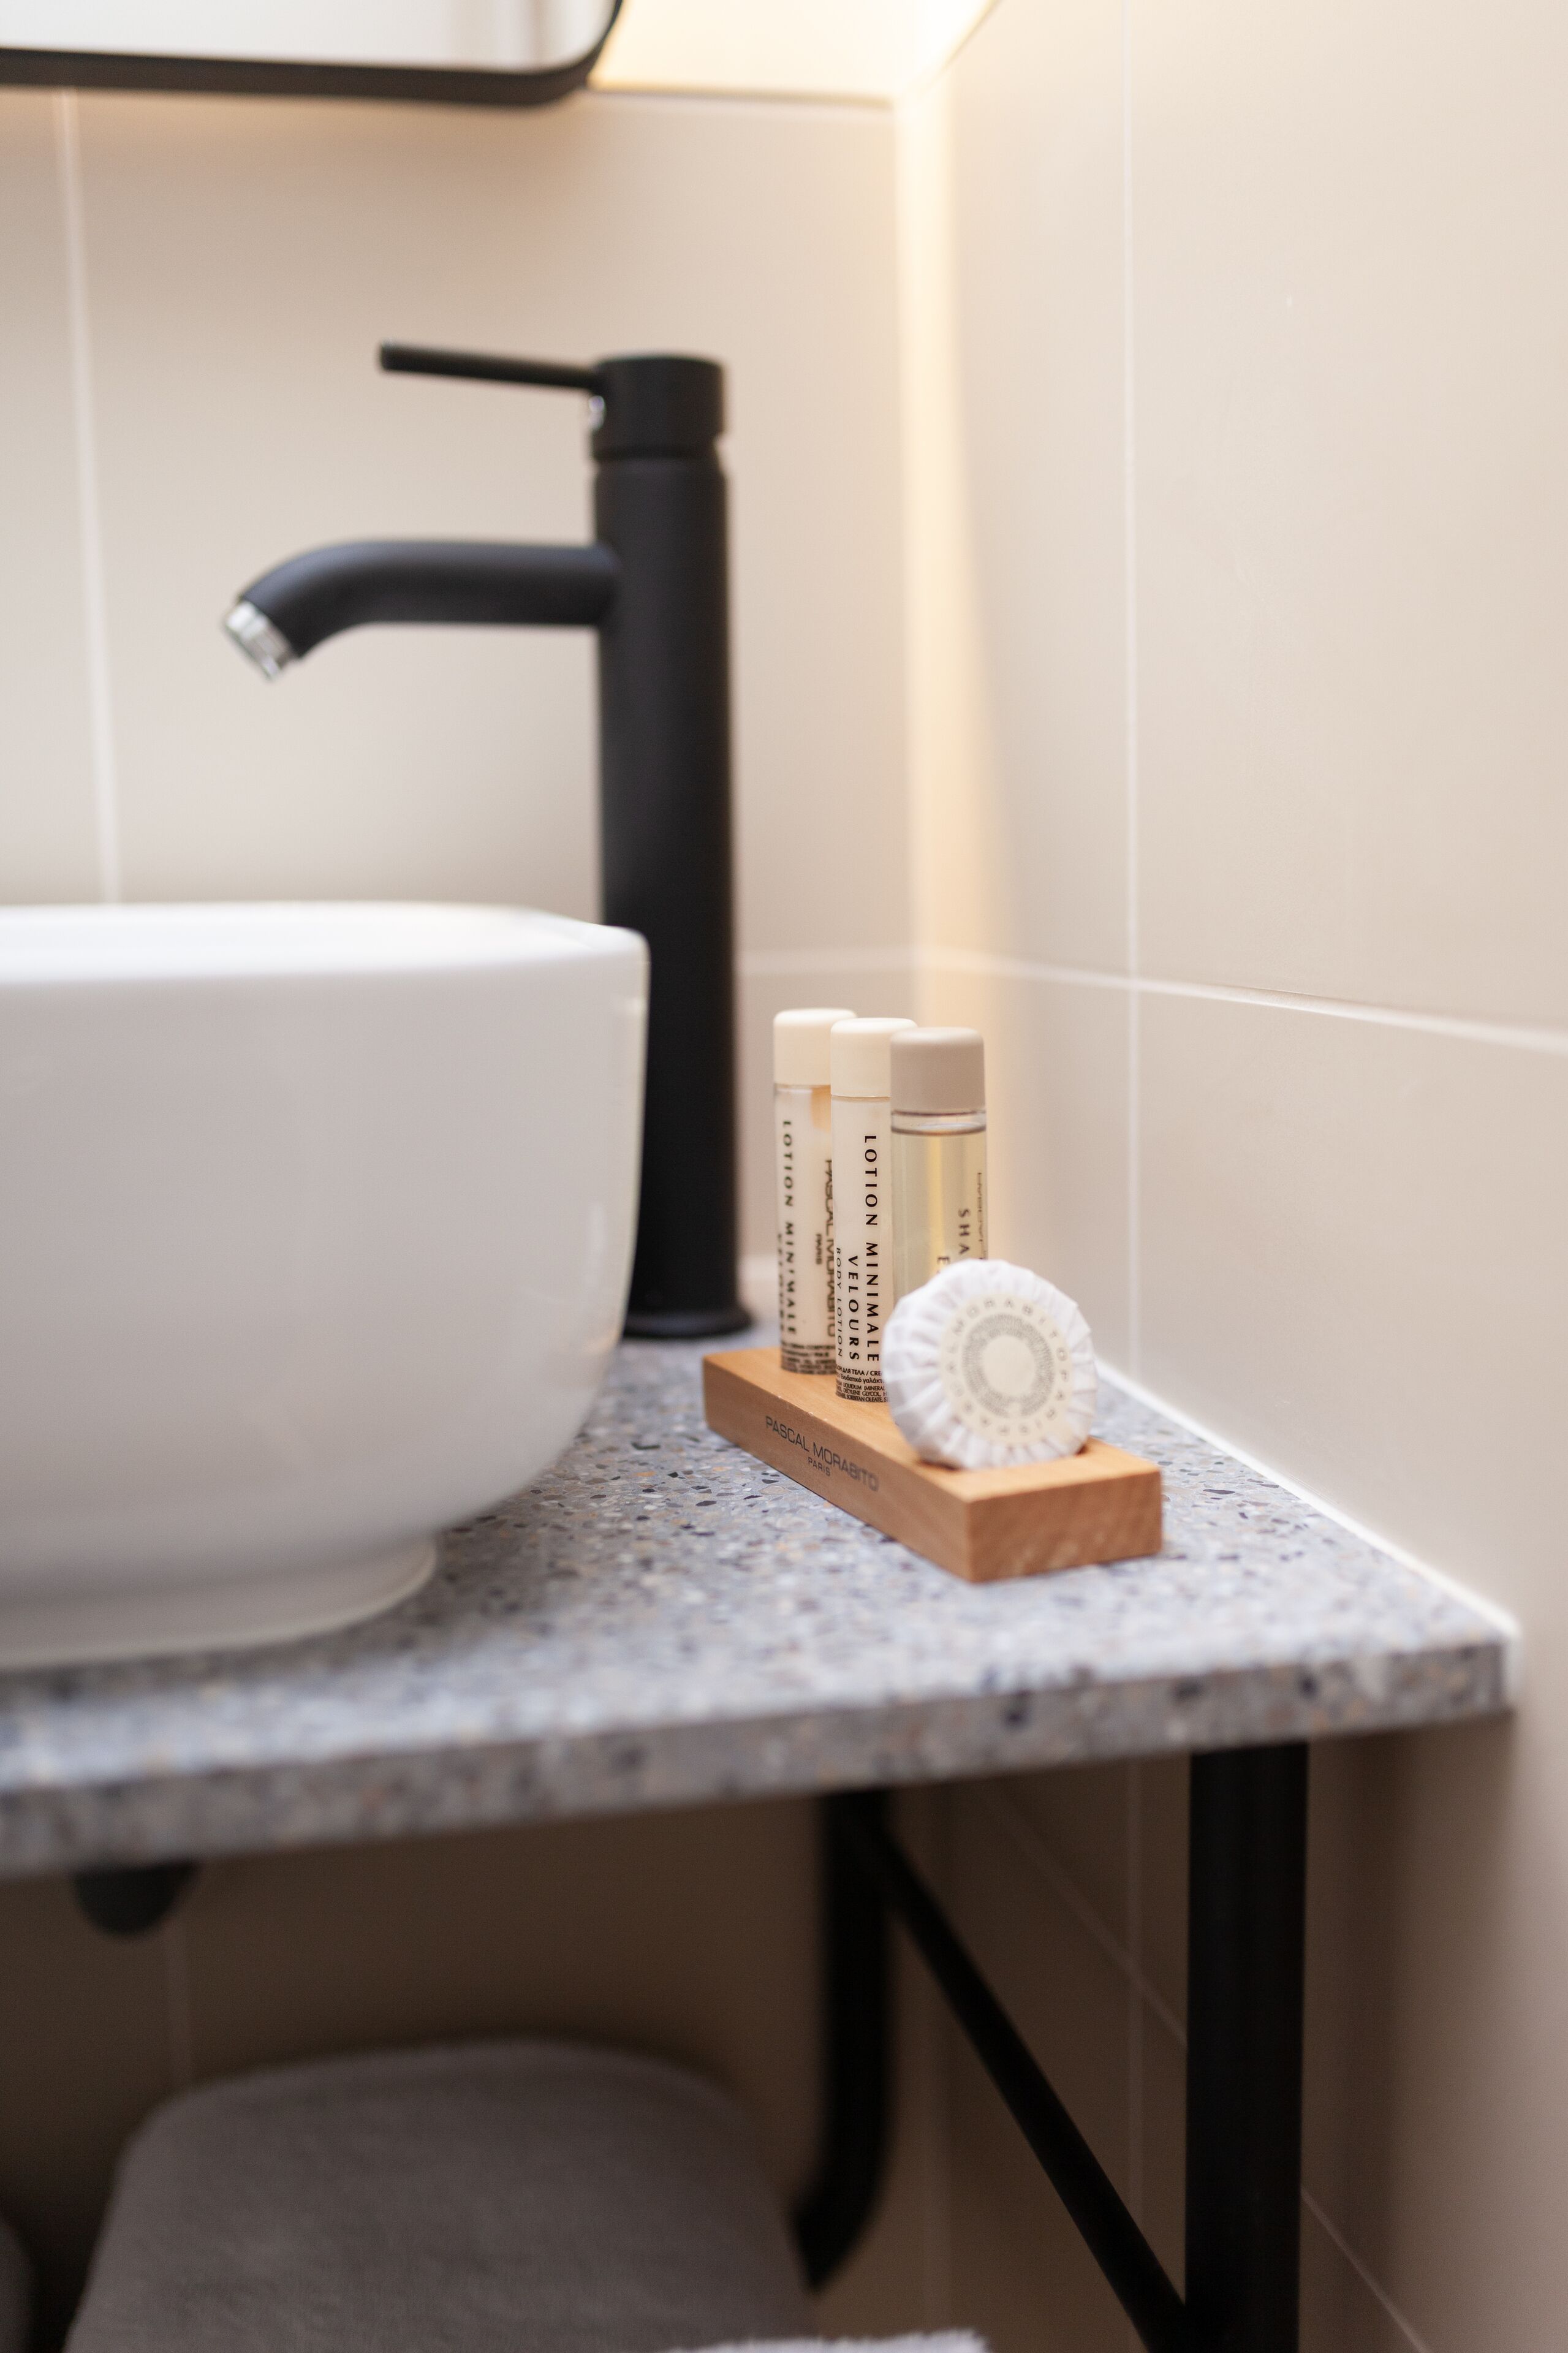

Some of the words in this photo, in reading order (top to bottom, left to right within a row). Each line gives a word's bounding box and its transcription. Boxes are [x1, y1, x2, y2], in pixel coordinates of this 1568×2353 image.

[783, 1121, 792, 1207] LOTION
[865, 1135, 877, 1225] LOTION
[958, 1208, 970, 1254] SHA
[848, 1256, 859, 1360] VELOURS
[866, 1242, 879, 1361] MINIMALE
[765, 1415, 809, 1453] PASCAL
[813, 1441, 879, 1491] MORABITO
[808, 1457, 831, 1477] PARIS
